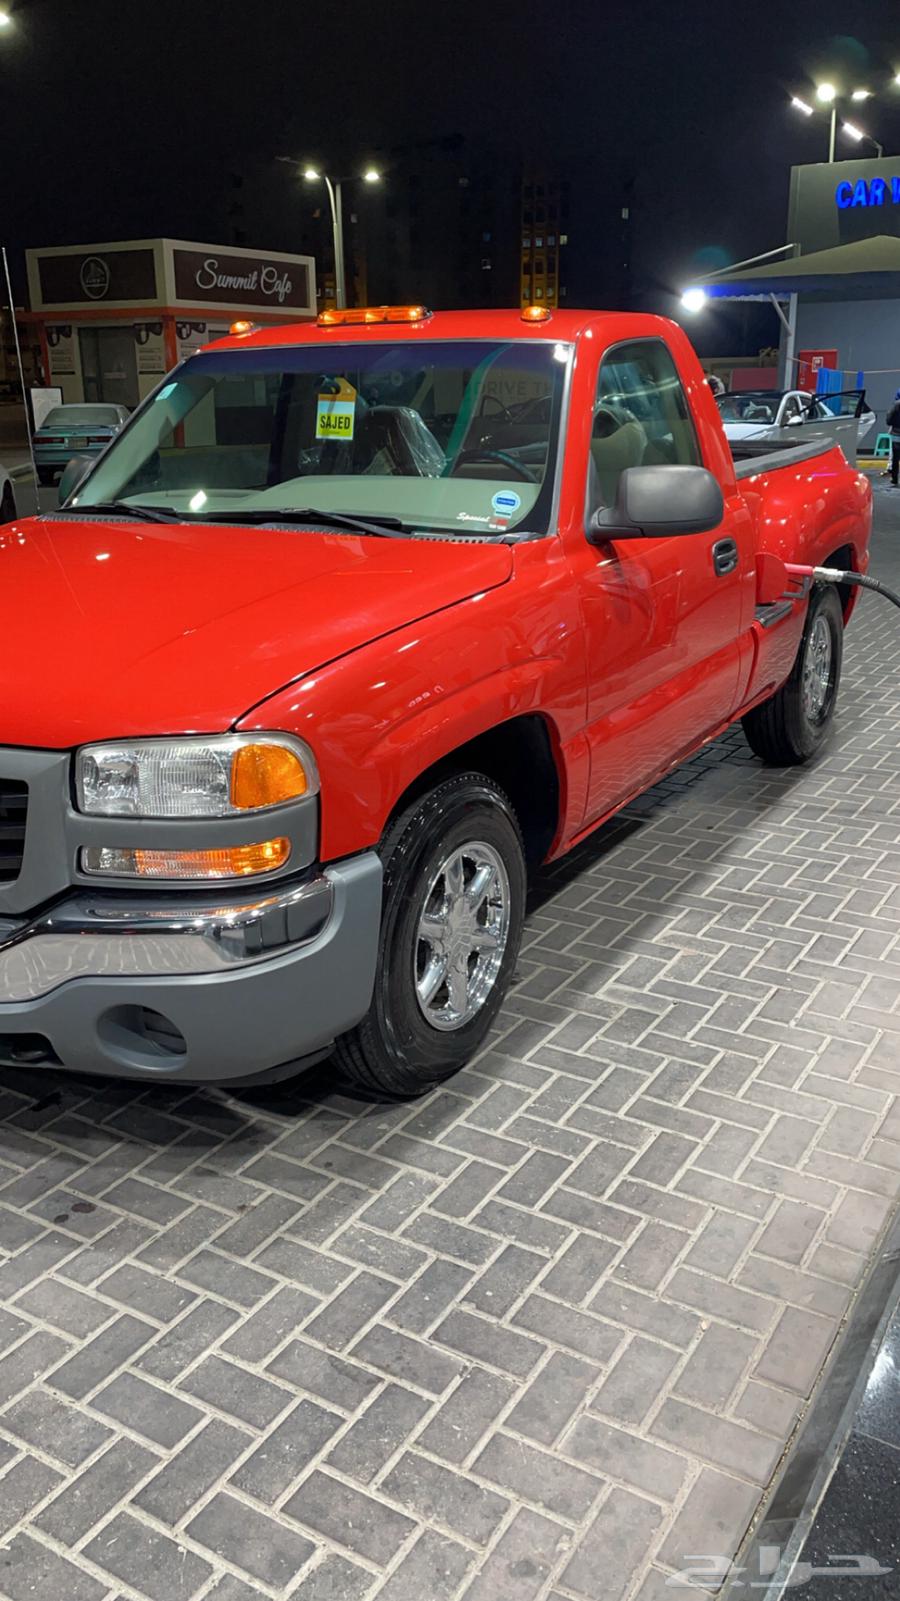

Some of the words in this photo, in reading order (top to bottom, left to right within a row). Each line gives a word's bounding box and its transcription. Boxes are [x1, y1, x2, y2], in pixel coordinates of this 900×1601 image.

[835, 177, 886, 208] CAR
[196, 259, 258, 290] Summit
[261, 265, 292, 303] Cafe
[474, 381, 528, 396] DRIVE
[319, 415, 351, 430] SAJED
